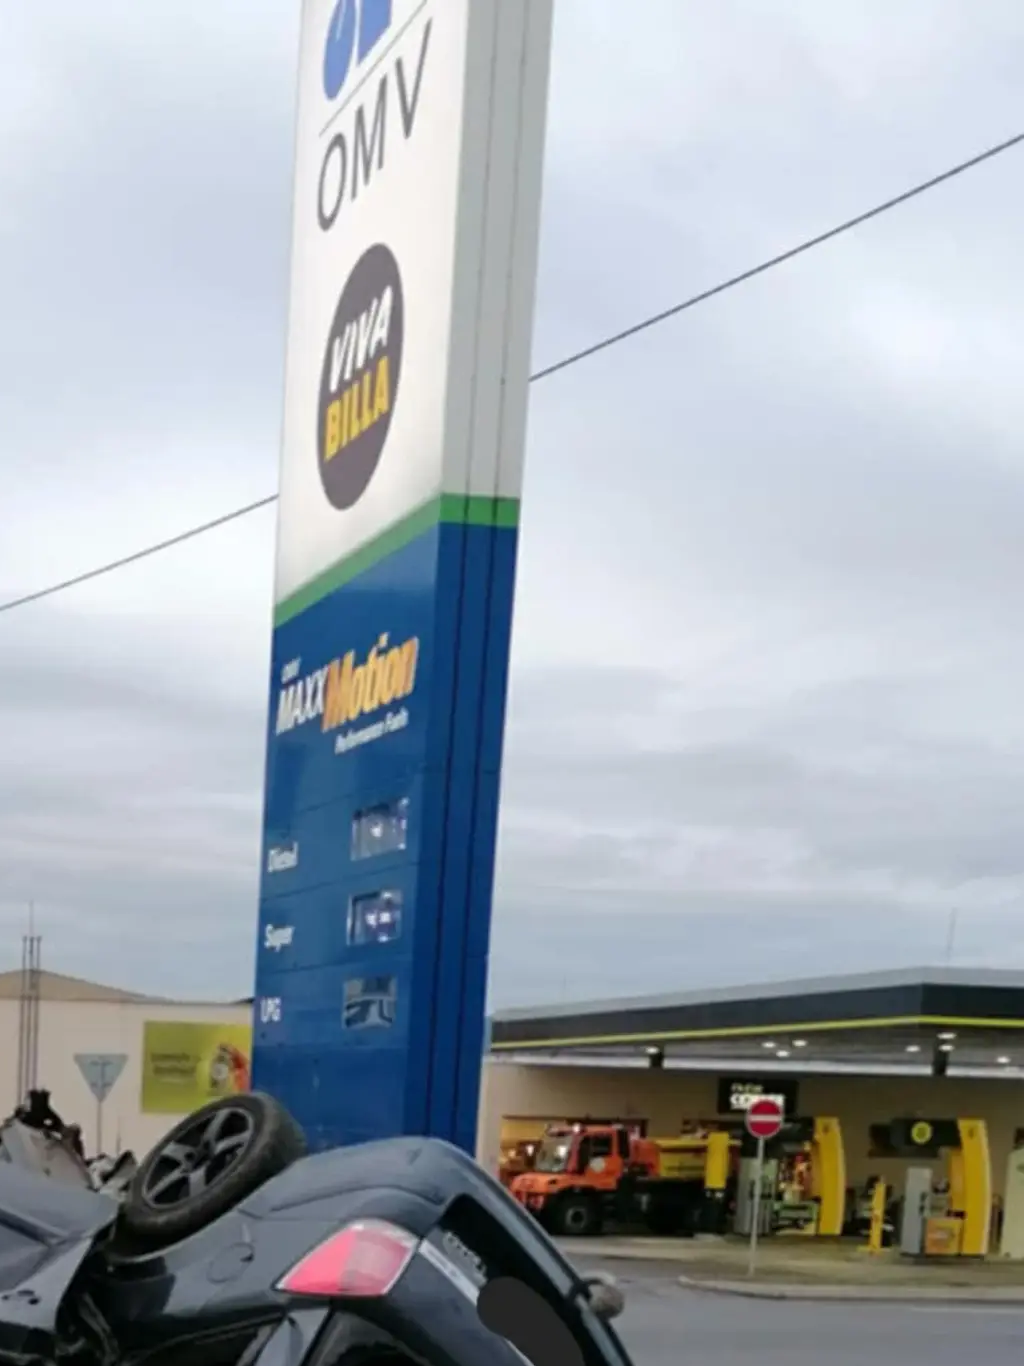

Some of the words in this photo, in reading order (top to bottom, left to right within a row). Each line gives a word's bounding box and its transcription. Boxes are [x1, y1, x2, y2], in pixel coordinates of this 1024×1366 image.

[316, 17, 433, 232] OMV
[328, 285, 394, 393] VIVA
[324, 355, 390, 462] BILLA
